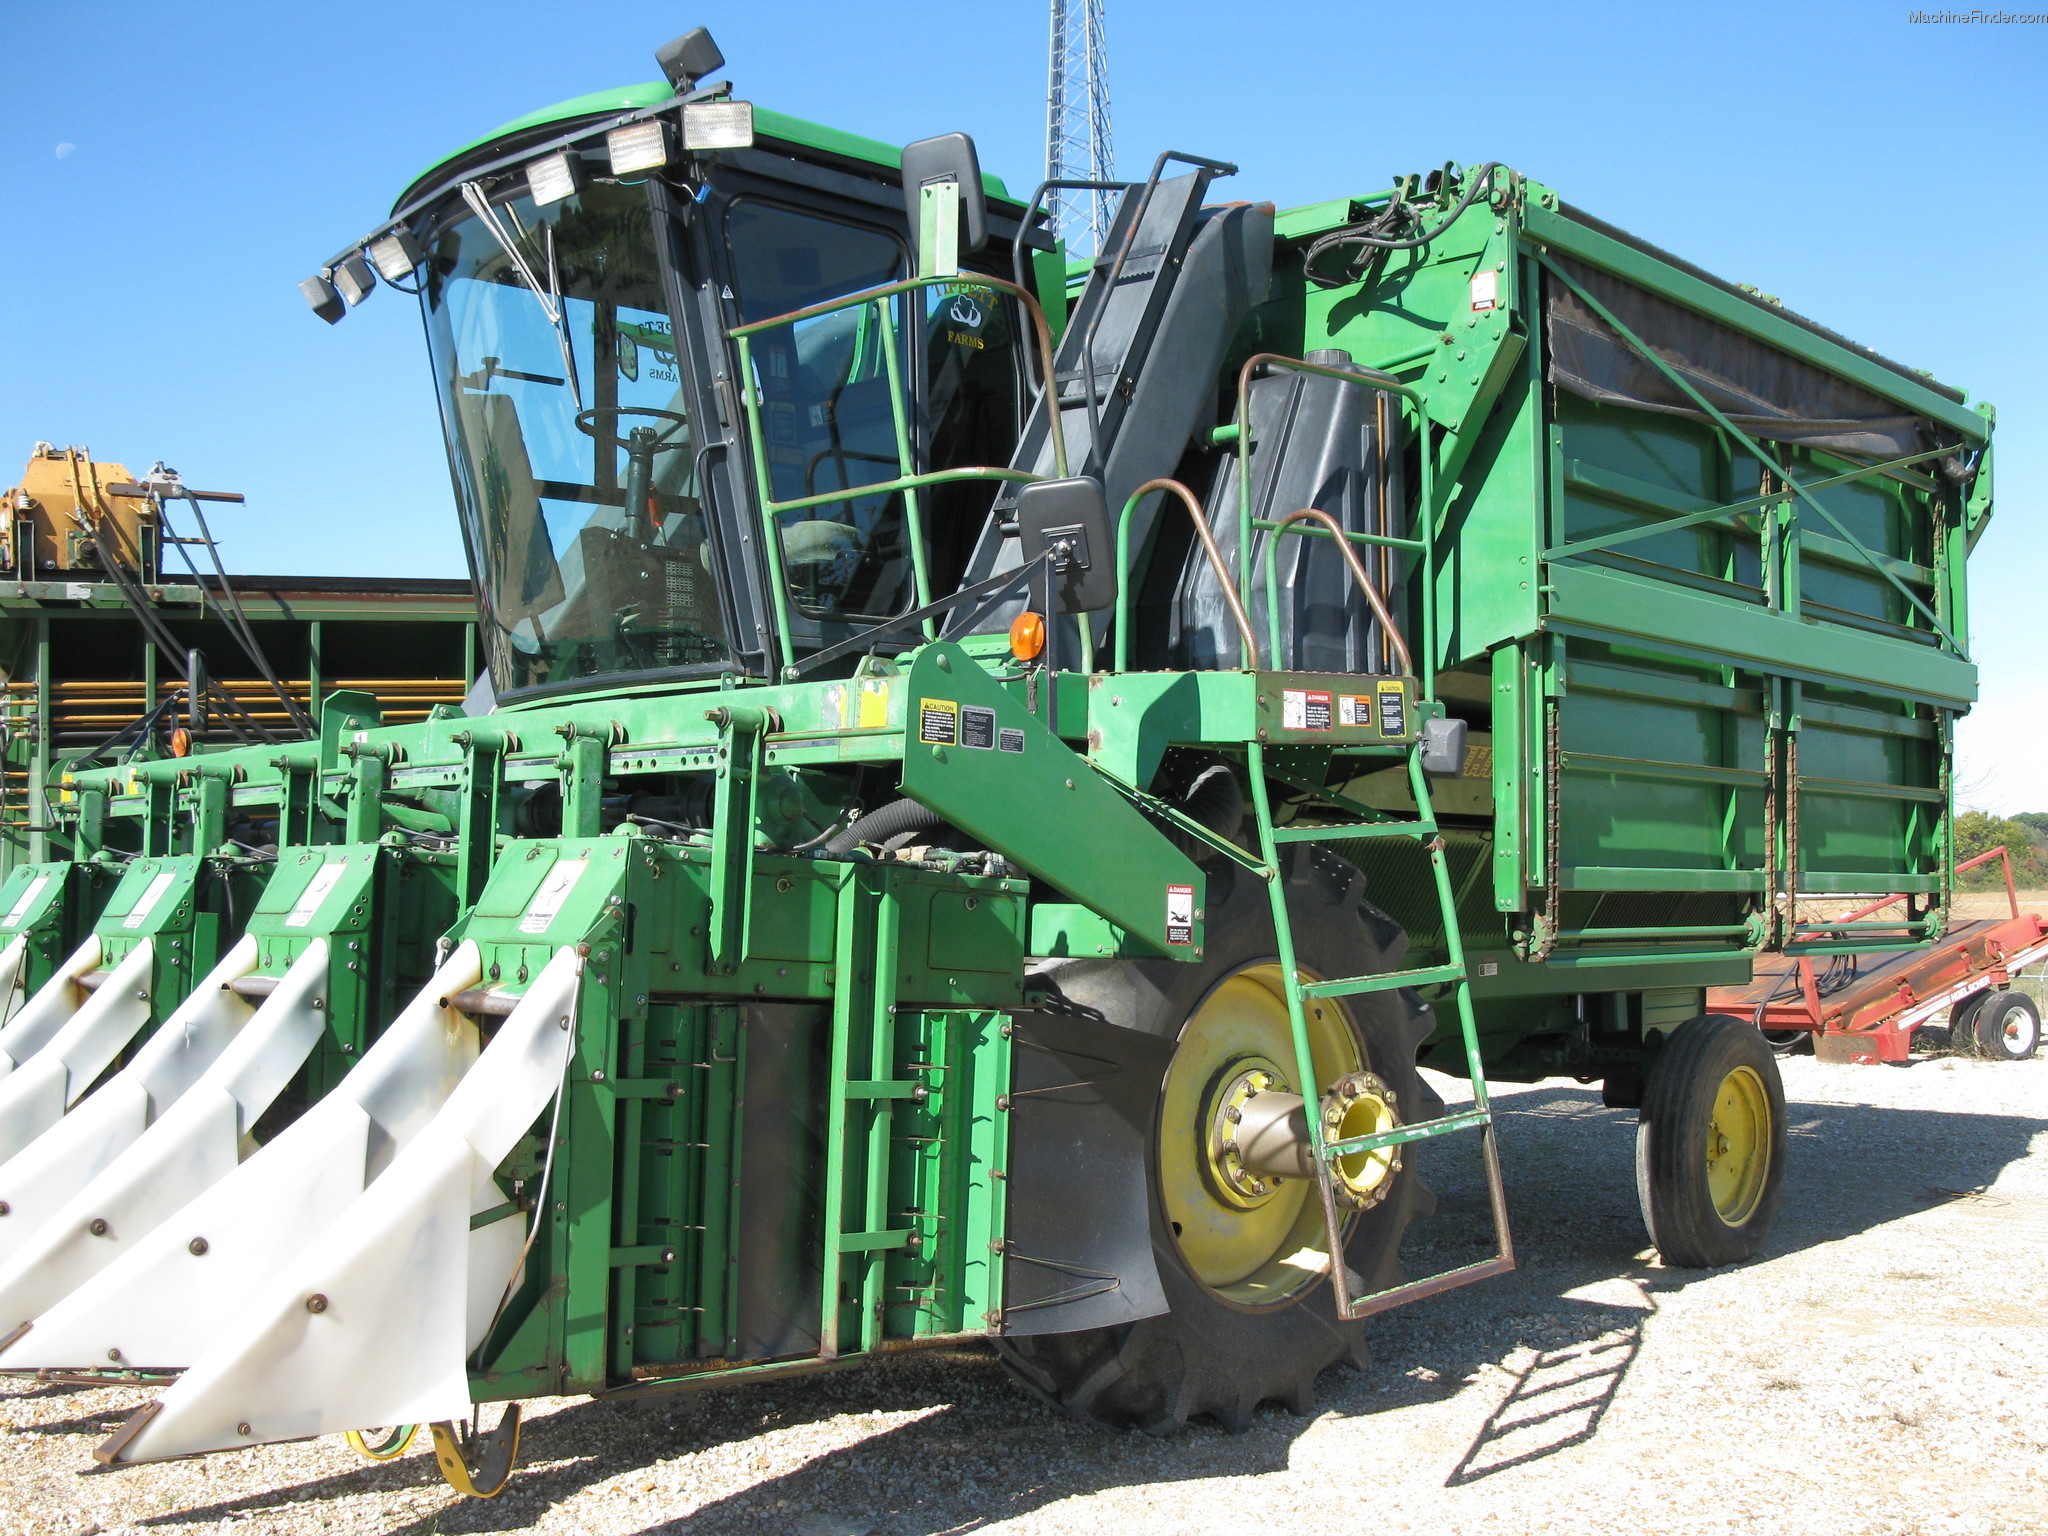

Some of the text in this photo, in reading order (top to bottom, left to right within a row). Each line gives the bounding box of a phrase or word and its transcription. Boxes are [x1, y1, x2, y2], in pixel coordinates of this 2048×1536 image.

[947, 330, 985, 350] FARMS
[929, 703, 954, 712] CAUTION
[1951, 975, 1991, 1003] HOELSCHER
